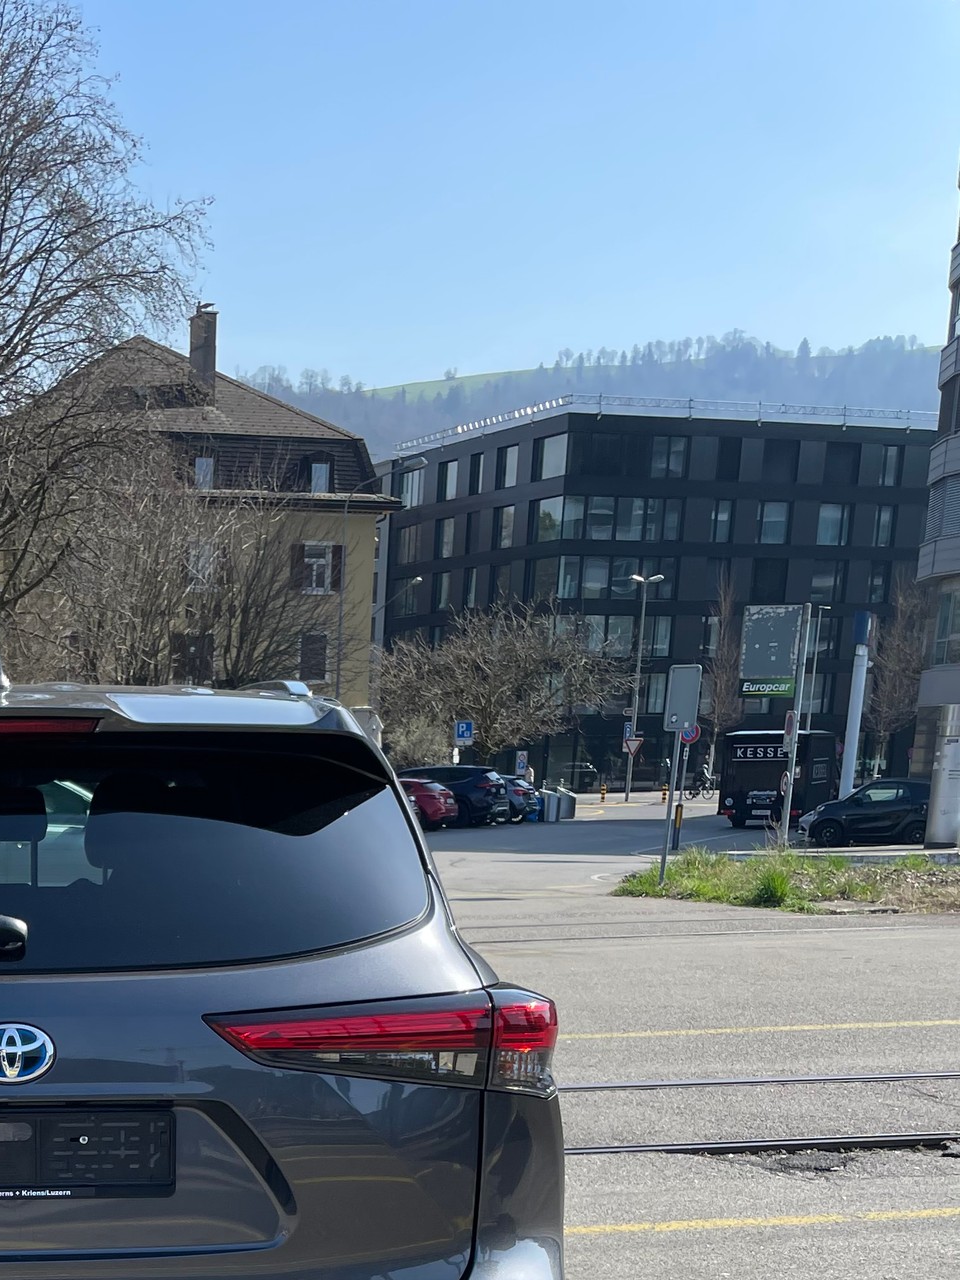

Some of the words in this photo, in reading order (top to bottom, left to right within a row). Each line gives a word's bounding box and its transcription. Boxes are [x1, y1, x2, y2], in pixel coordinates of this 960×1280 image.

[742, 682, 790, 692] Europcar
[459, 723, 466, 735] P
[736, 747, 786, 758] KESSE
[21, 1189, 71, 1197] Kriens/Luzern
